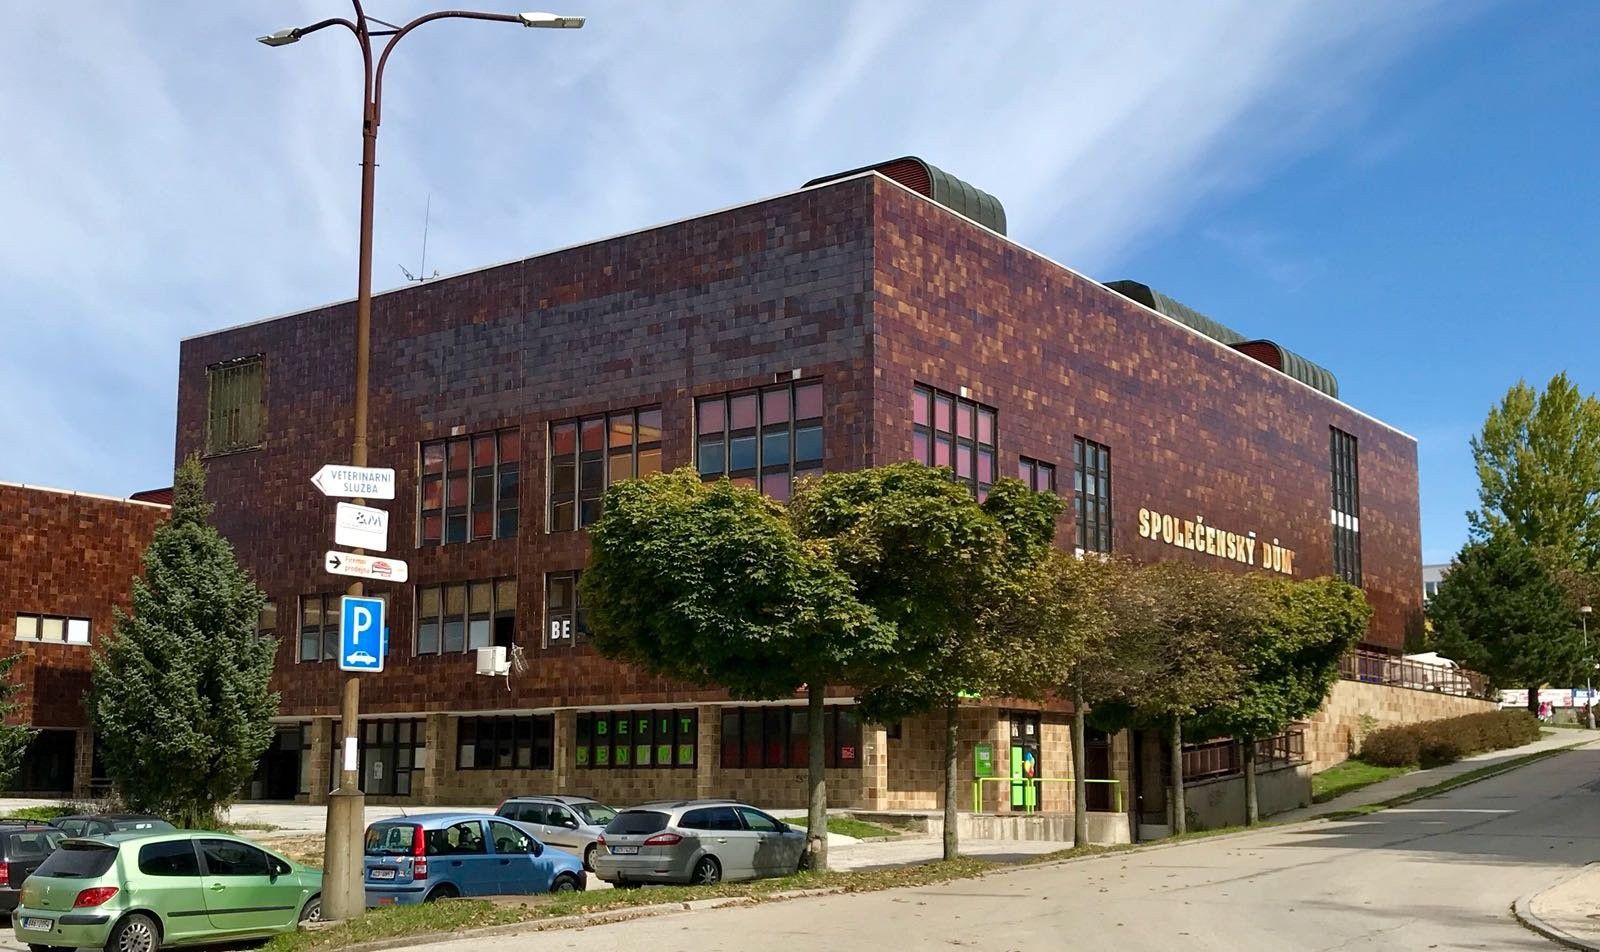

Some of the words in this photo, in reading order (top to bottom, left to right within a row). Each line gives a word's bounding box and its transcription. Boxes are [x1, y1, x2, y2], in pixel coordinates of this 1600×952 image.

[1138, 508, 1256, 565] SPOLEČENSKÝ
[1262, 538, 1296, 575] DŮM
[353, 606, 372, 645] P
